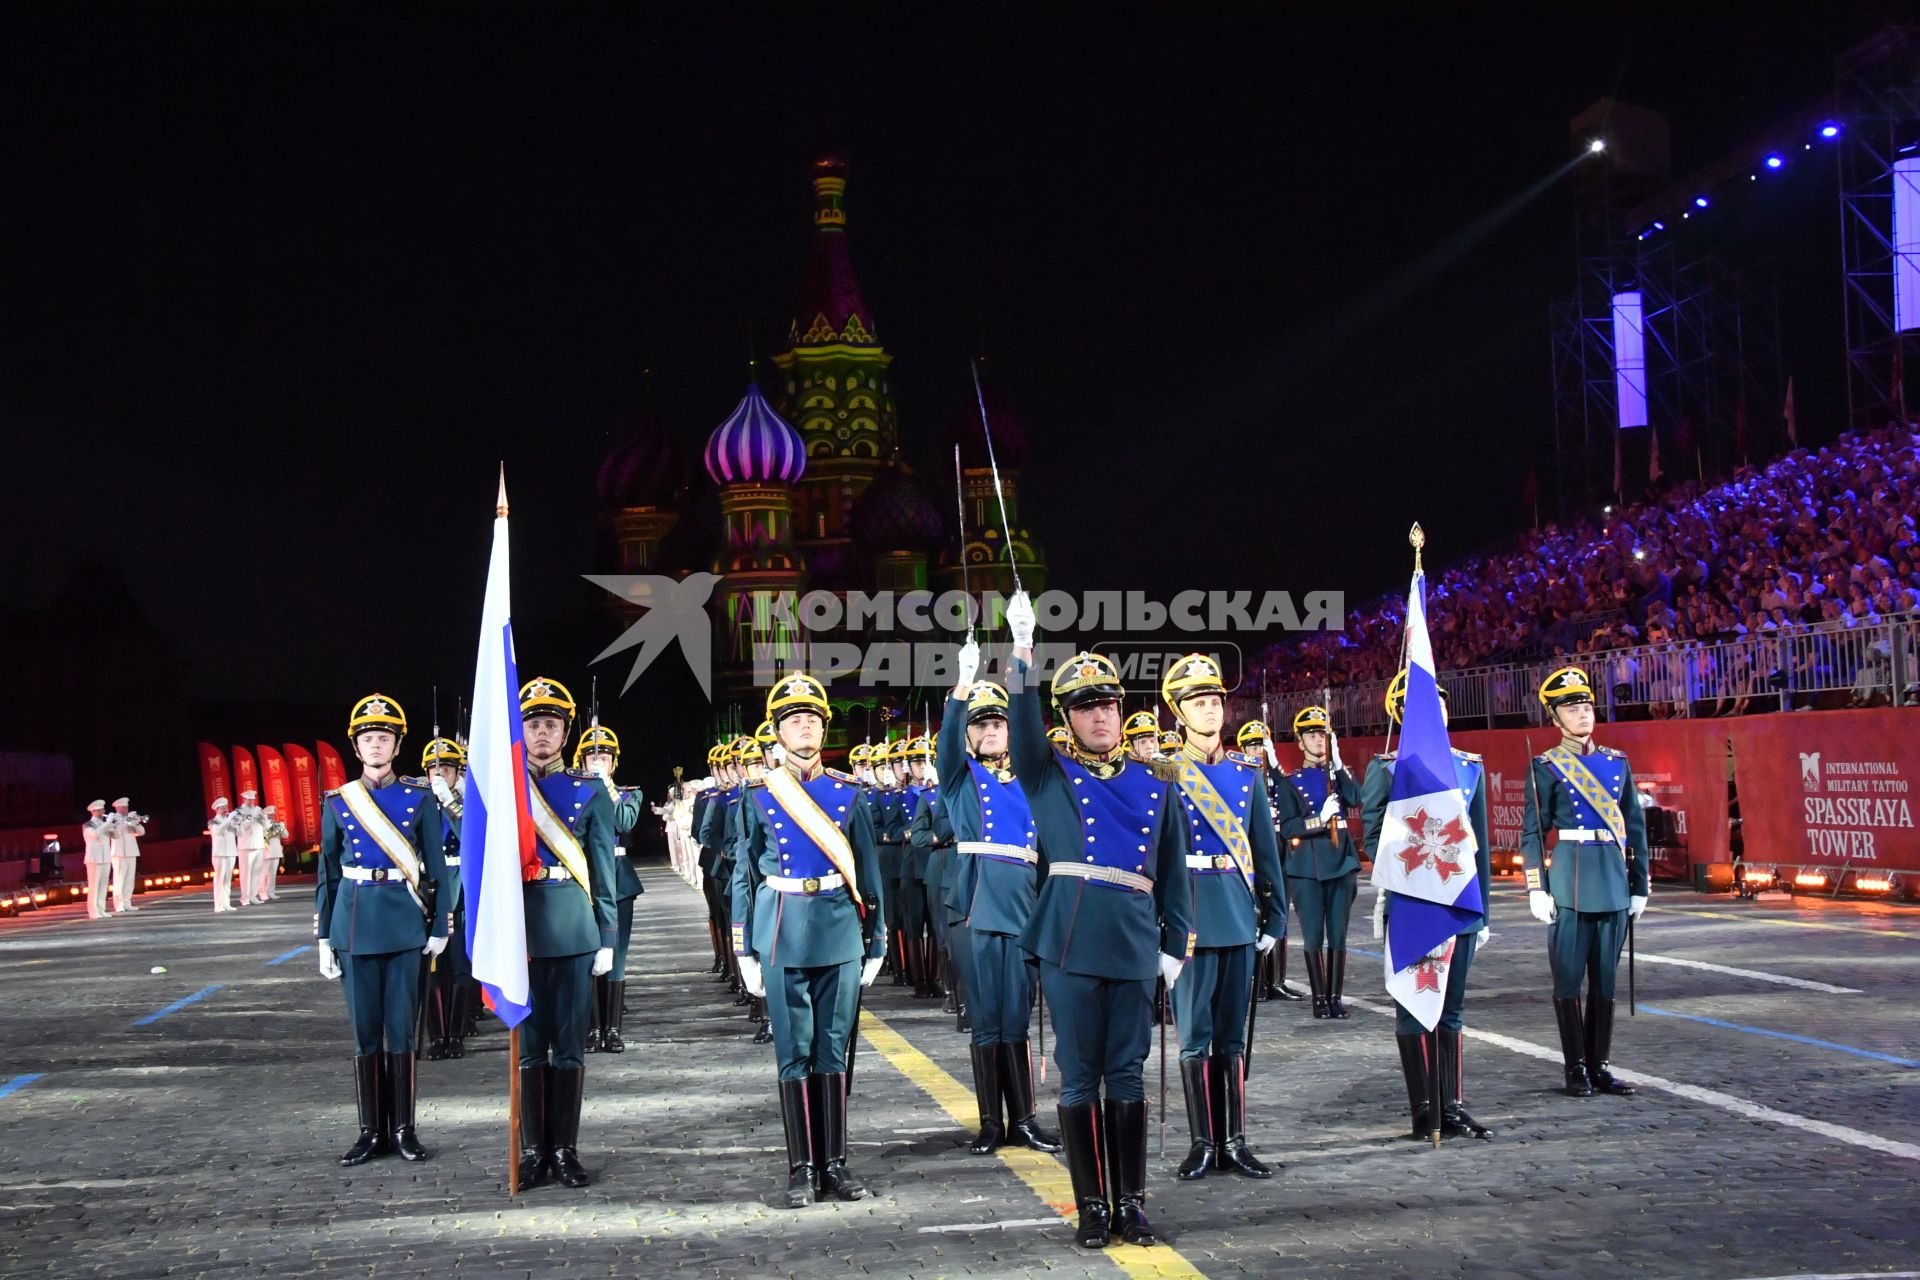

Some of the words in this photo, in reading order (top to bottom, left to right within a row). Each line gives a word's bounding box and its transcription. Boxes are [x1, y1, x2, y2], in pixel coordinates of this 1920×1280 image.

[1826, 762, 1899, 774] INTERNATIONAL
[1827, 780, 1869, 792] MILITARY
[1872, 780, 1908, 792] TATTOO
[1804, 797, 1914, 827] SPASSKAYA
[1807, 829, 1877, 859] TOWER
